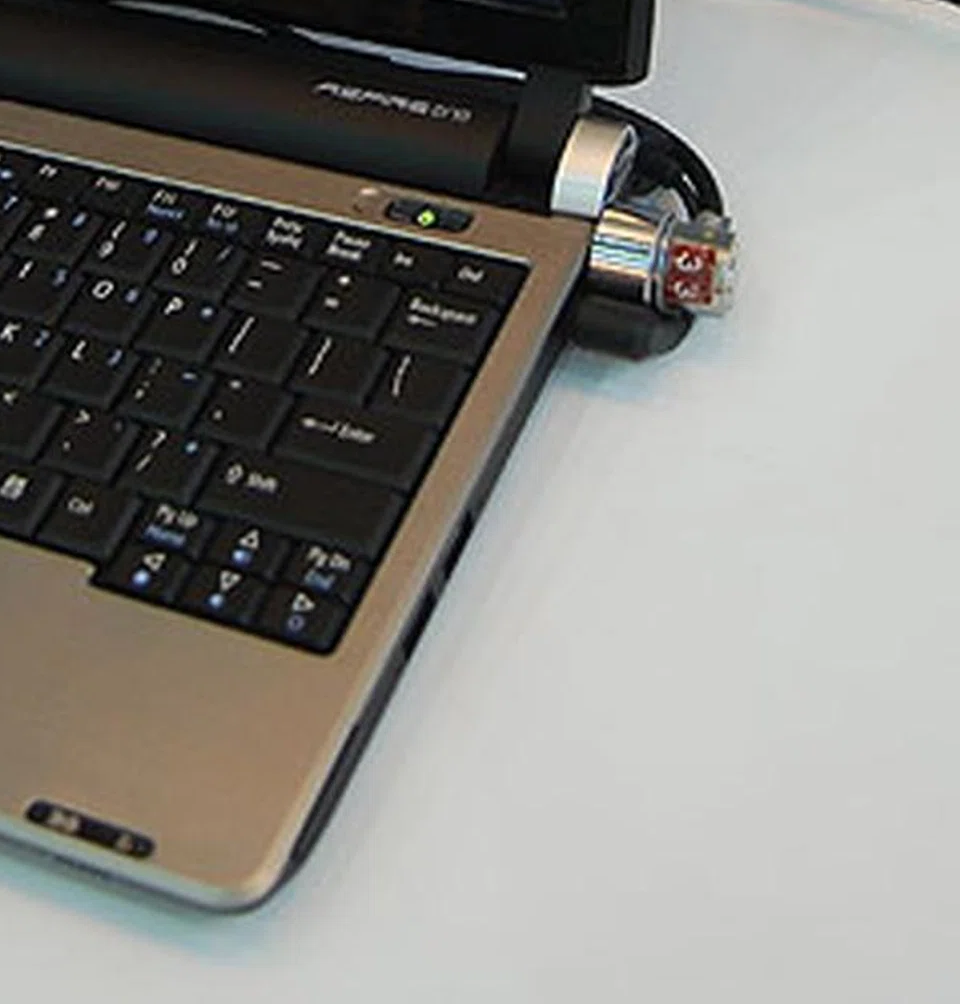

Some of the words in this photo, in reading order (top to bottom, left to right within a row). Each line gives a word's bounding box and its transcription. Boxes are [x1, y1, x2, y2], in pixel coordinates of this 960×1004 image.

[92, 280, 115, 299] O
[164, 296, 184, 315] P
[0, 323, 20, 342] K
[71, 340, 86, 360] L
